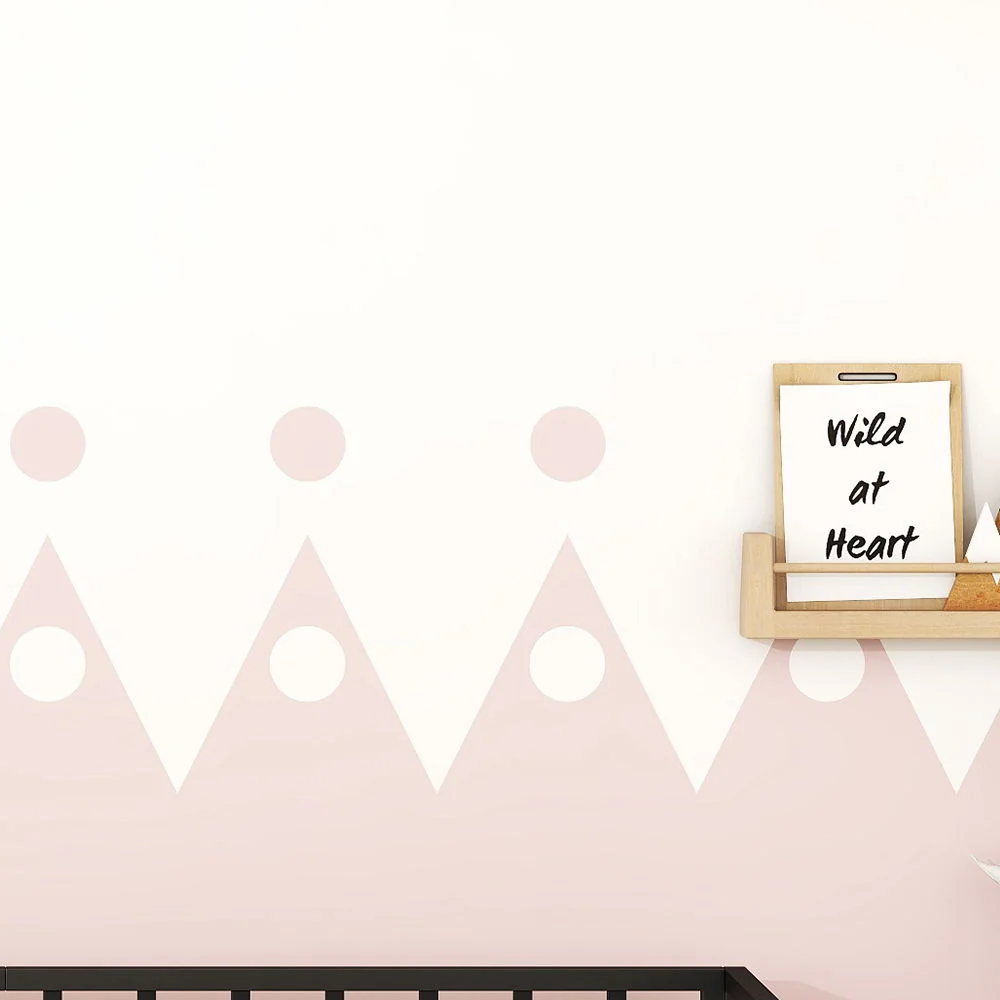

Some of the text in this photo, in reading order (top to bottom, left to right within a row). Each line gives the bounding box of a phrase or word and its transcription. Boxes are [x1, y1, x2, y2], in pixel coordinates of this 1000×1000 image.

[827, 411, 906, 447] Wild
[848, 471, 889, 505] at
[825, 526, 919, 560] Heart
